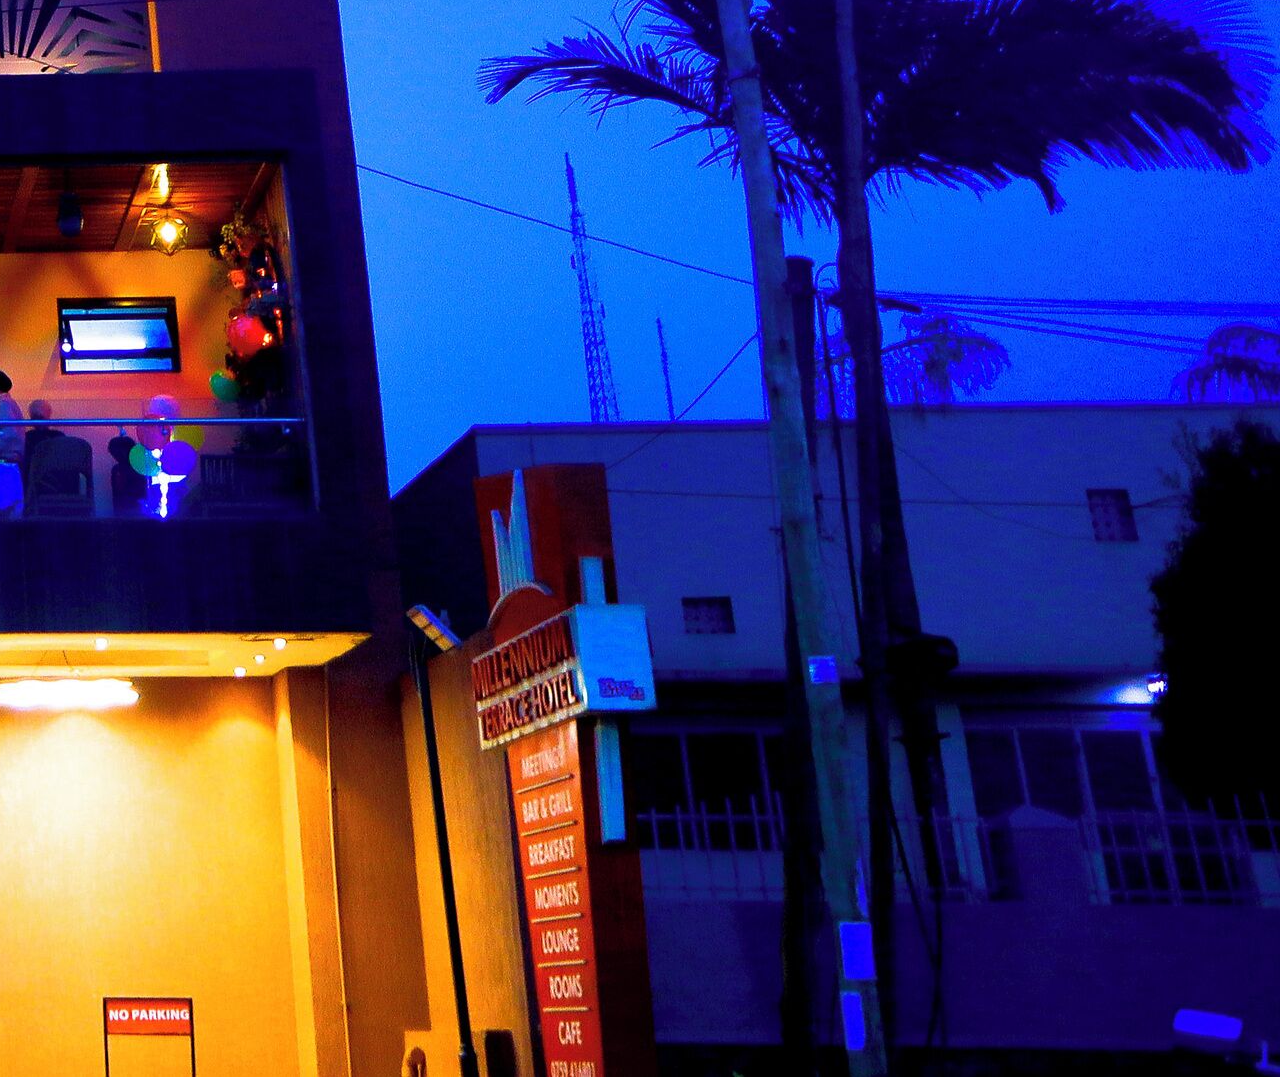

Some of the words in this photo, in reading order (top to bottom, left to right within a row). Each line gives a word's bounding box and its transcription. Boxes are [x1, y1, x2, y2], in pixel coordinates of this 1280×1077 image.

[472, 617, 576, 702] MILLENNIUM
[480, 690, 532, 741] TERRACE
[531, 670, 579, 720] HOTEL
[522, 799, 540, 823] BAR
[549, 789, 573, 817] GRILL
[528, 835, 575, 867] BREAKFAST
[534, 881, 579, 910] MOMENTS
[541, 928, 580, 954] LOUNGE
[548, 974, 583, 1000] ROOMS
[109, 1009, 129, 1021] NO
[131, 1009, 190, 1021] PARKING
[558, 1021, 582, 1045] CAFE
